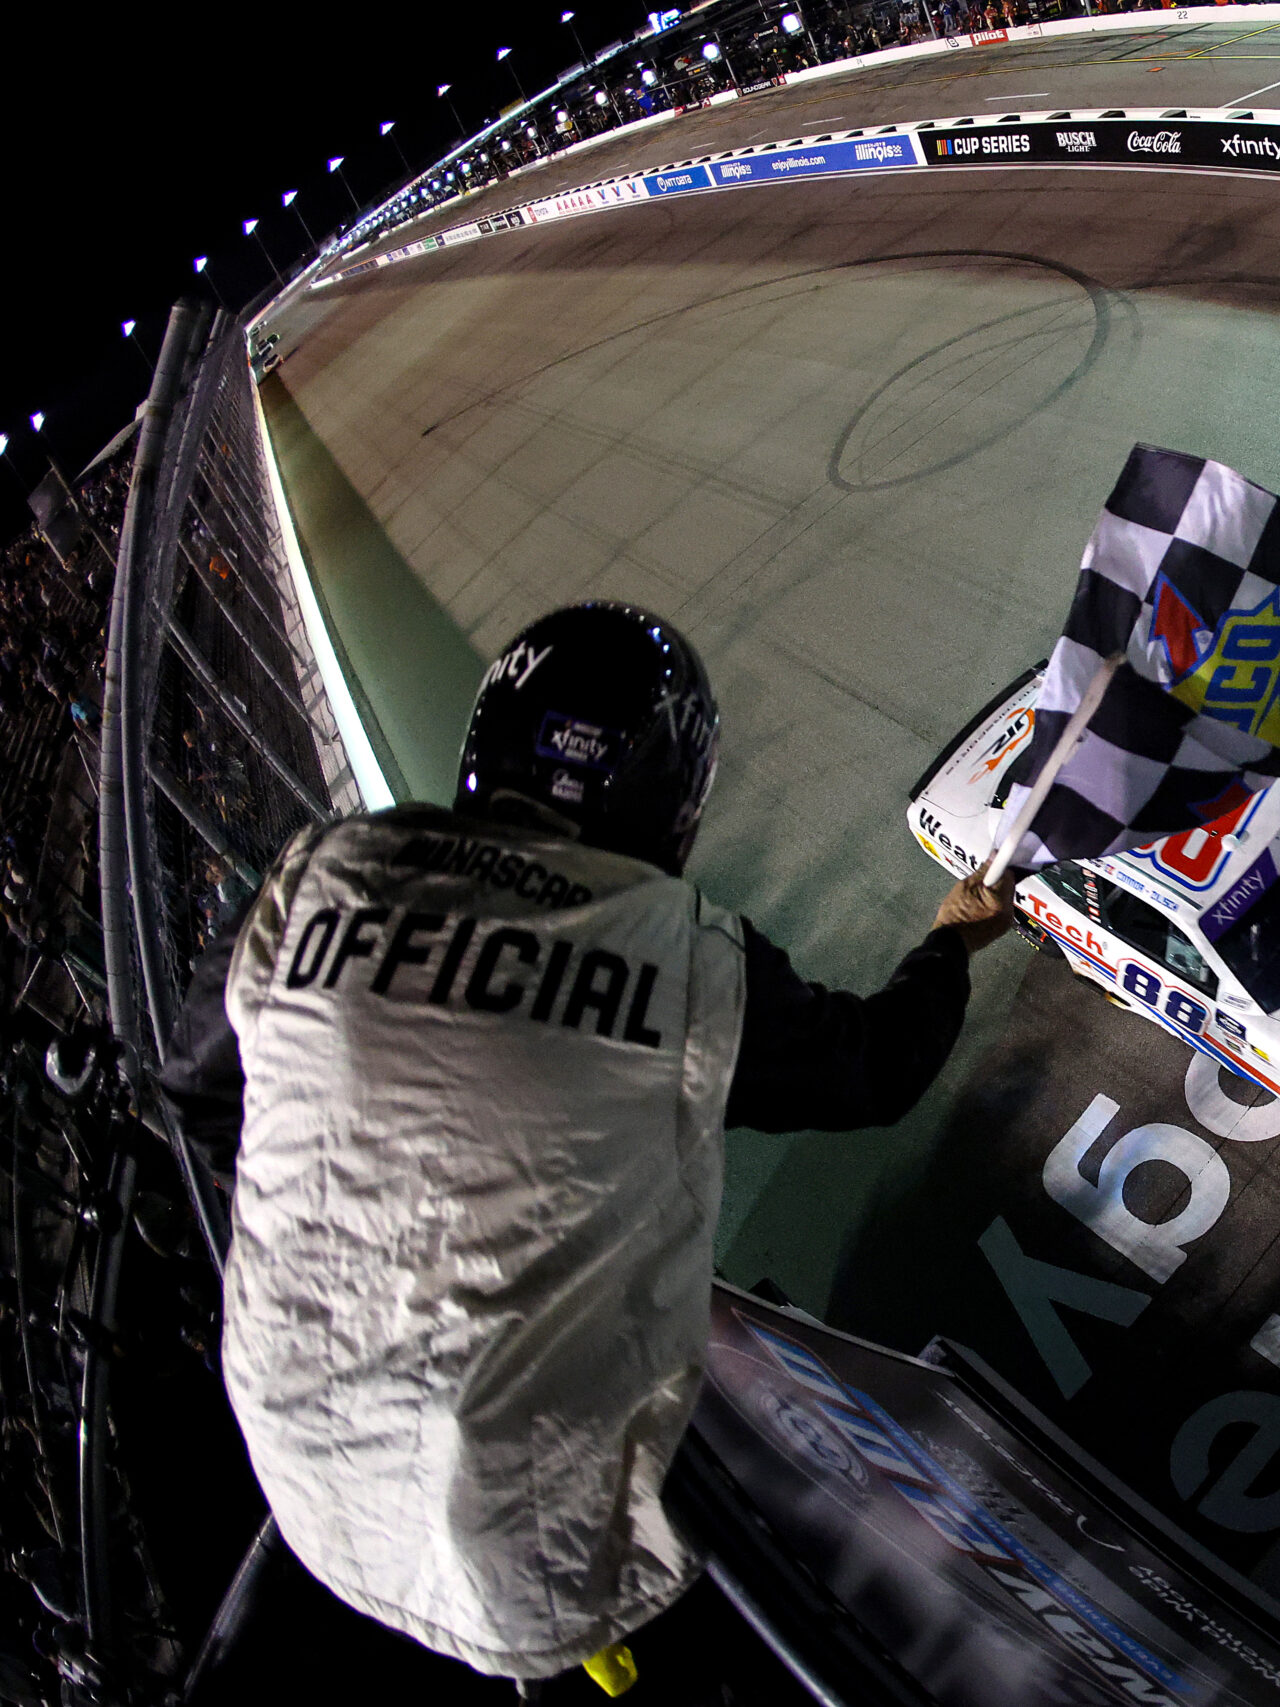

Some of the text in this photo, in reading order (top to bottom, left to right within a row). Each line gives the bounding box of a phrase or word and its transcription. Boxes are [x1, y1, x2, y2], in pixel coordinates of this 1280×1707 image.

[1176, 10, 1189, 20] 22
[954, 134, 1031, 156] CUP SERIES
[1057, 131, 1096, 148] BUSCH
[1066, 145, 1091, 153] LIGHT
[771, 155, 826, 171] enjoyillinois.com
[551, 727, 609, 761] xfinity
[448, 837, 596, 910] NASCAR
[1211, 869, 1267, 926] xfinity
[286, 905, 662, 1049] OFFICIAL
[1123, 963, 1207, 1034] 88
[1126, 1562, 1195, 1622] Wide
